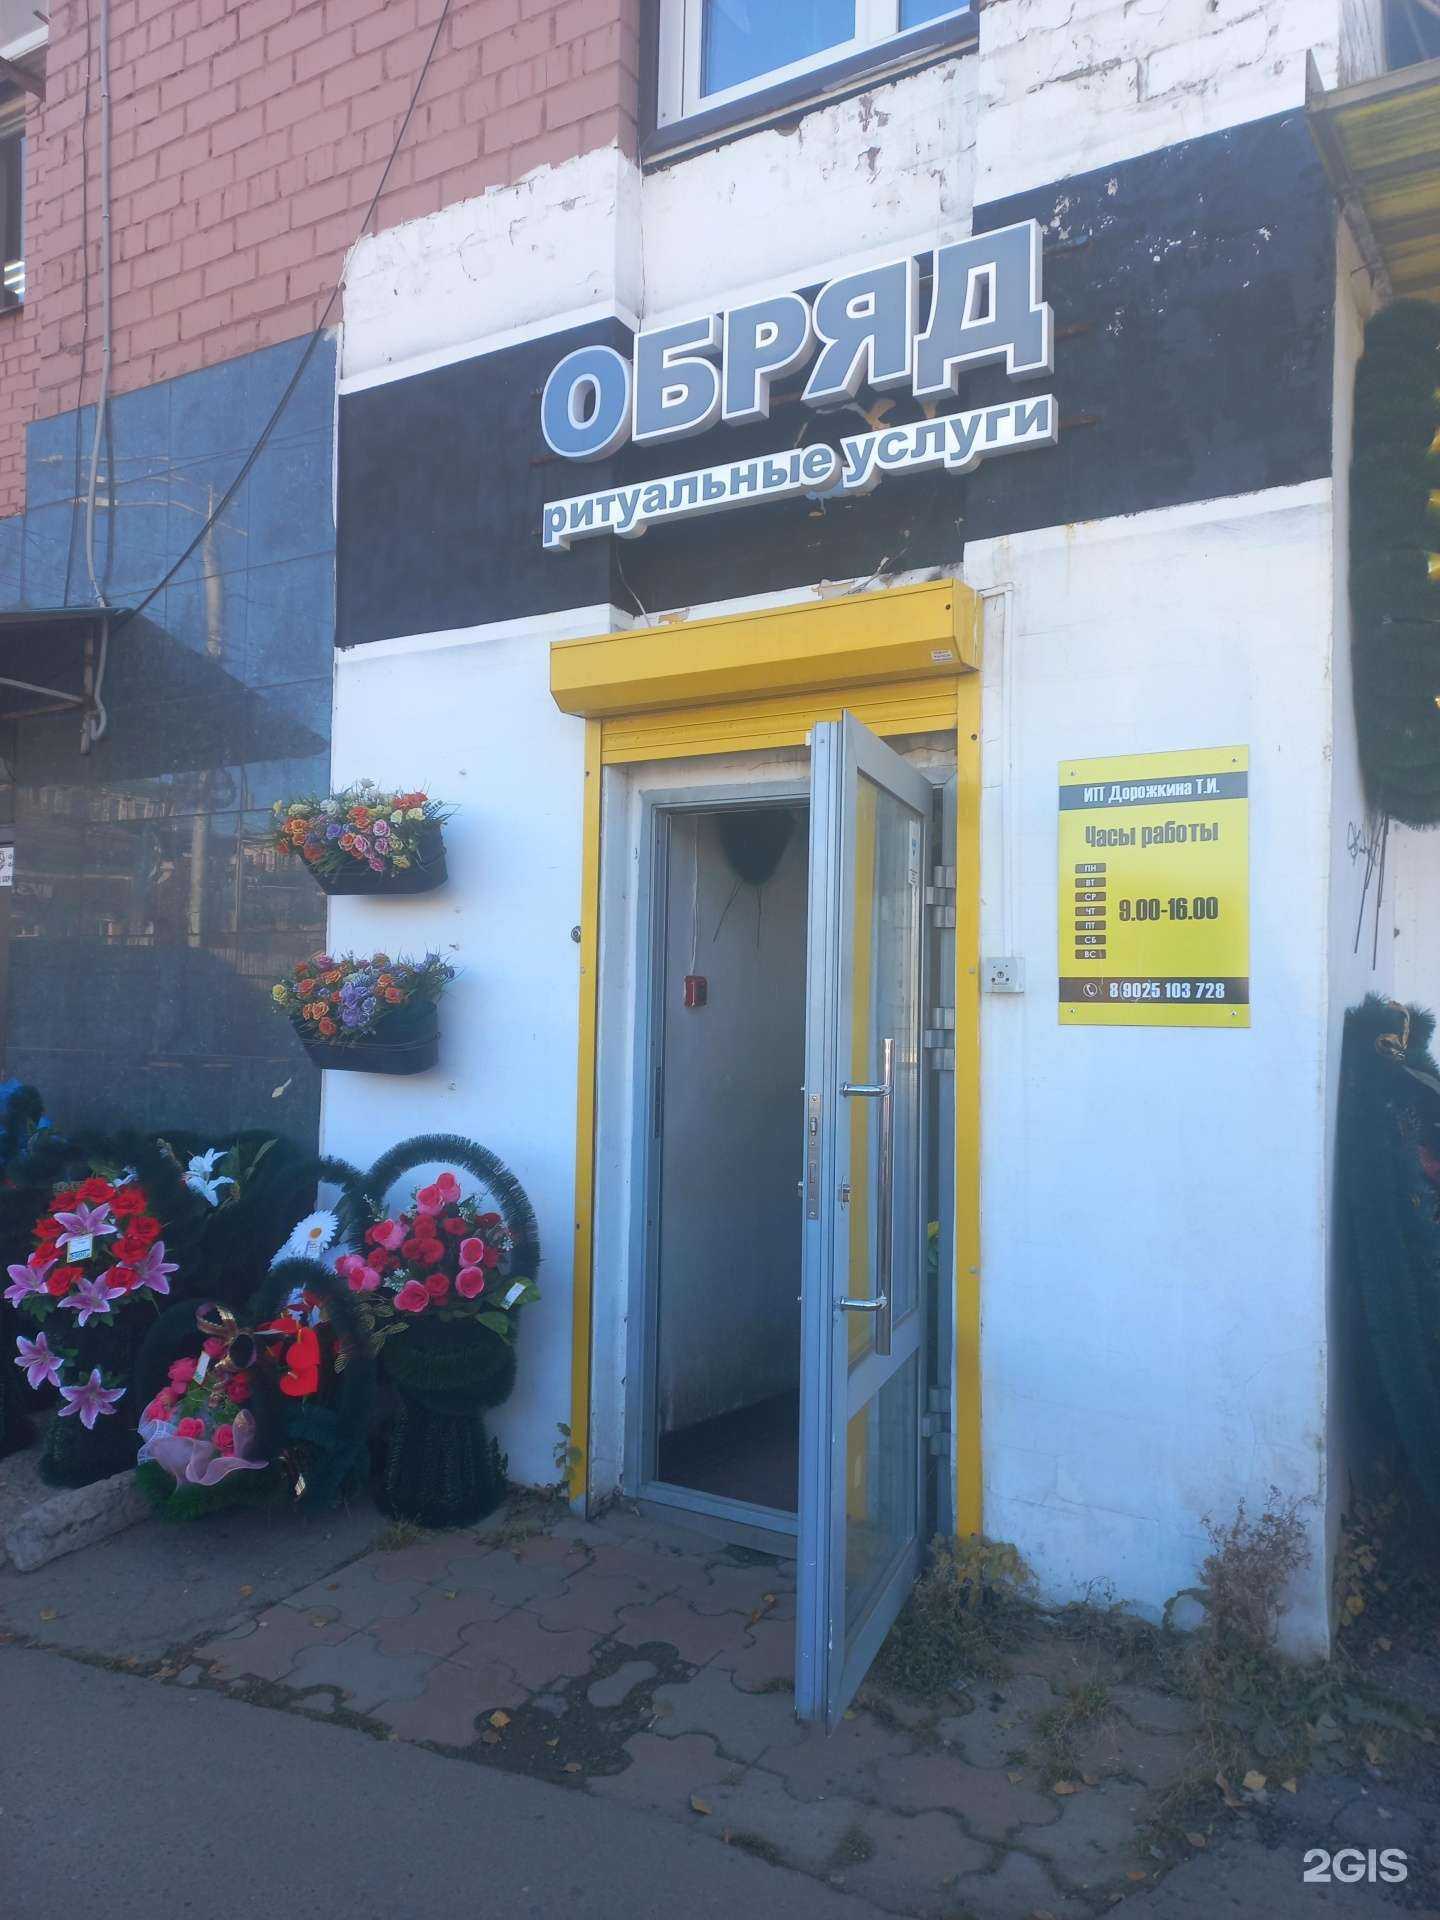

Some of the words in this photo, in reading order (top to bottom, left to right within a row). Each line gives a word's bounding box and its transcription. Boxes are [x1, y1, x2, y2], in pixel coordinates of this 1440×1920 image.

[541, 218, 1053, 462] ОБРЯД
[544, 446, 832, 545] ритуальные
[842, 397, 1050, 484] услуги
[1084, 787, 1105, 802] ИП
[1108, 783, 1192, 803] Дорожкина
[1196, 778, 1220, 795] Т.И.
[1085, 825, 1136, 848] Часы
[1141, 821, 1219, 848] работы
[1084, 864, 1097, 872] ПН
[1085, 879, 1096, 887] ВТ
[1084, 893, 1097, 901] СР
[1085, 908, 1096, 916] ЧТ
[1119, 896, 1219, 921] 9.00-16.00
[1085, 922, 1096, 930] ПТ
[1084, 936, 1097, 944] СБ
[1084, 950, 1097, 958] ВС
[1165, 982, 1191, 998] 103
[1195, 982, 1225, 998] 728
